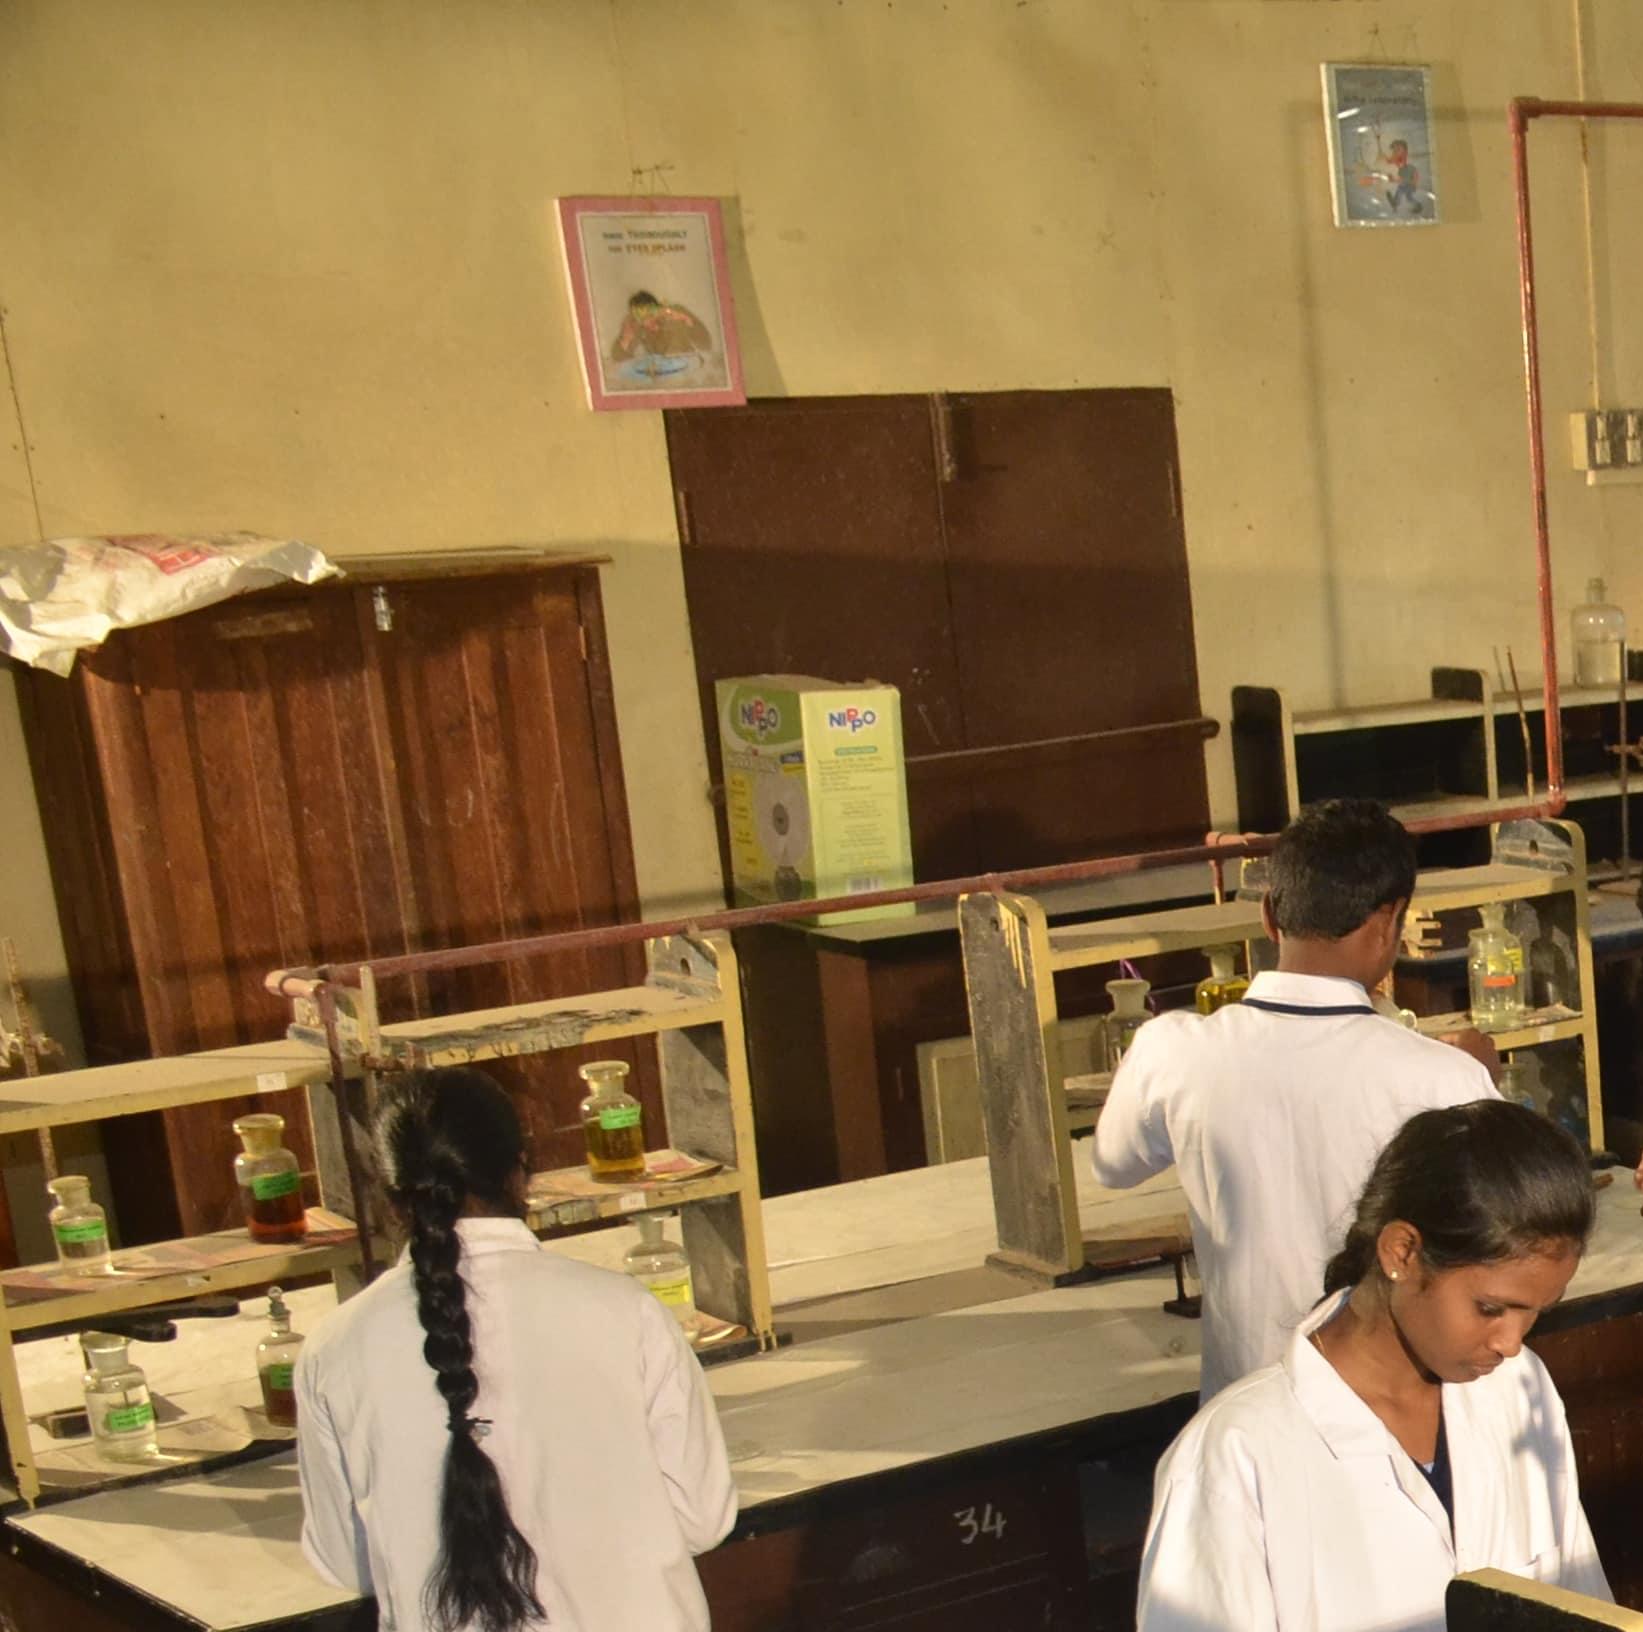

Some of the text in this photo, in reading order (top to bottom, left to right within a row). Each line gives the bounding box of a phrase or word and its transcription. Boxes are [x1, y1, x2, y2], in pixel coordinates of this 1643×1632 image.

[741, 699, 778, 734] NIPPO
[829, 708, 876, 733] NIPPO
[953, 1503, 1007, 1545] 34
